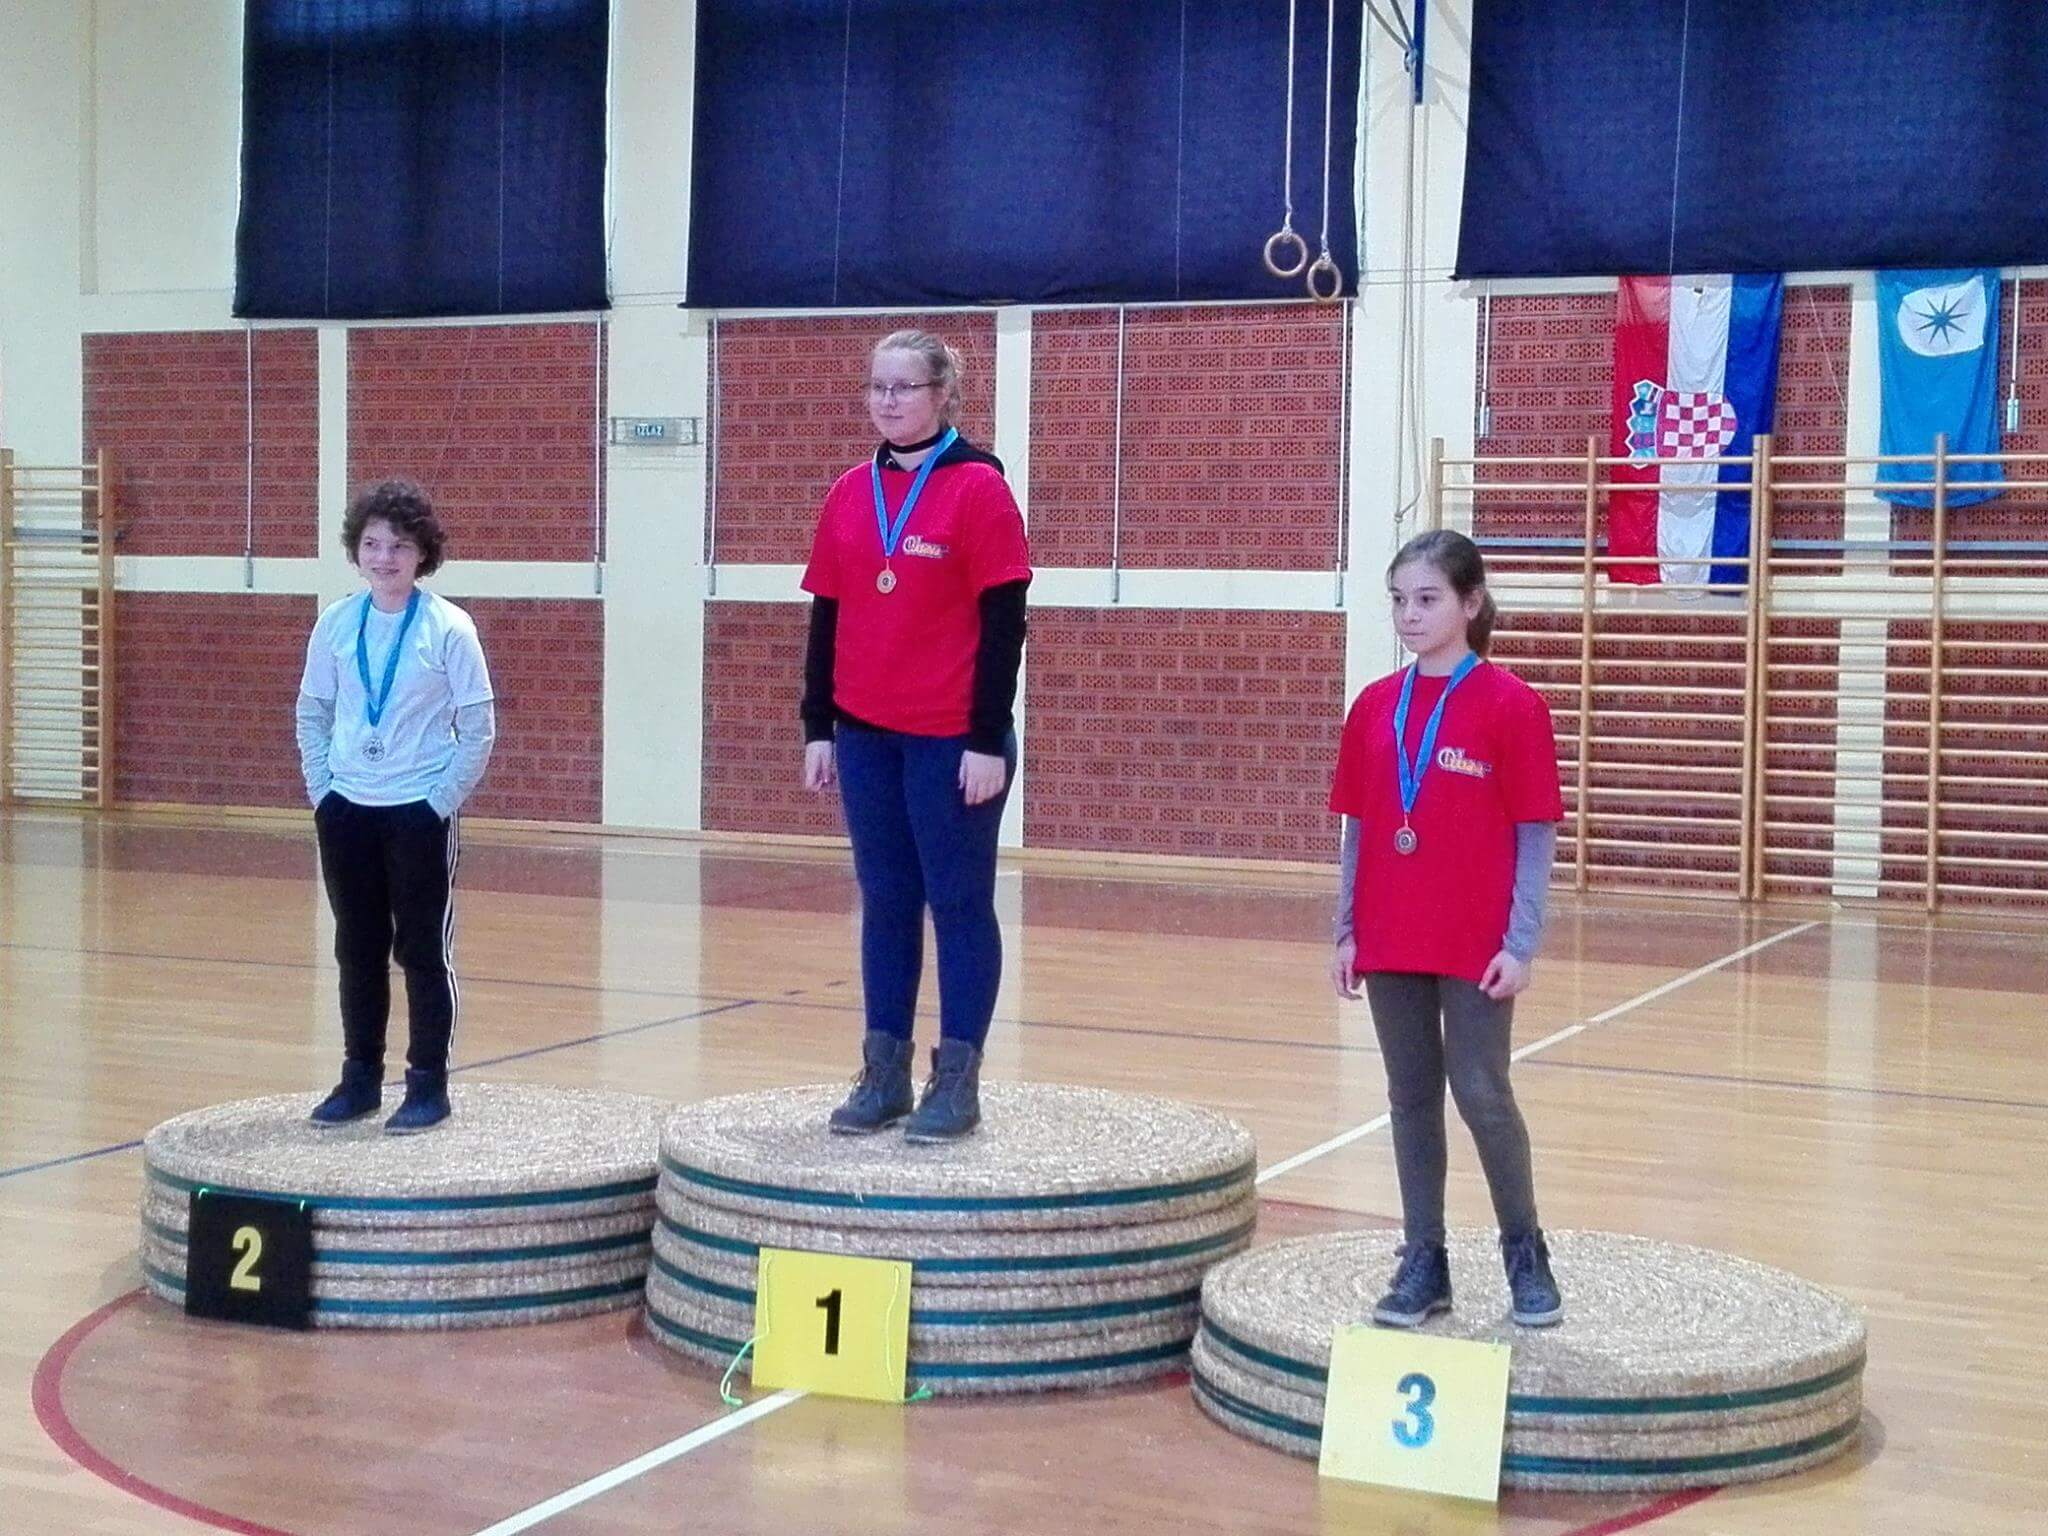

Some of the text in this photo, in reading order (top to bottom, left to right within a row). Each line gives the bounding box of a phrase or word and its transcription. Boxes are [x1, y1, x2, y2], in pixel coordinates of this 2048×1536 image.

[230, 1226, 262, 1291] 2
[816, 1289, 842, 1355] 1
[1392, 1372, 1436, 1449] 3
